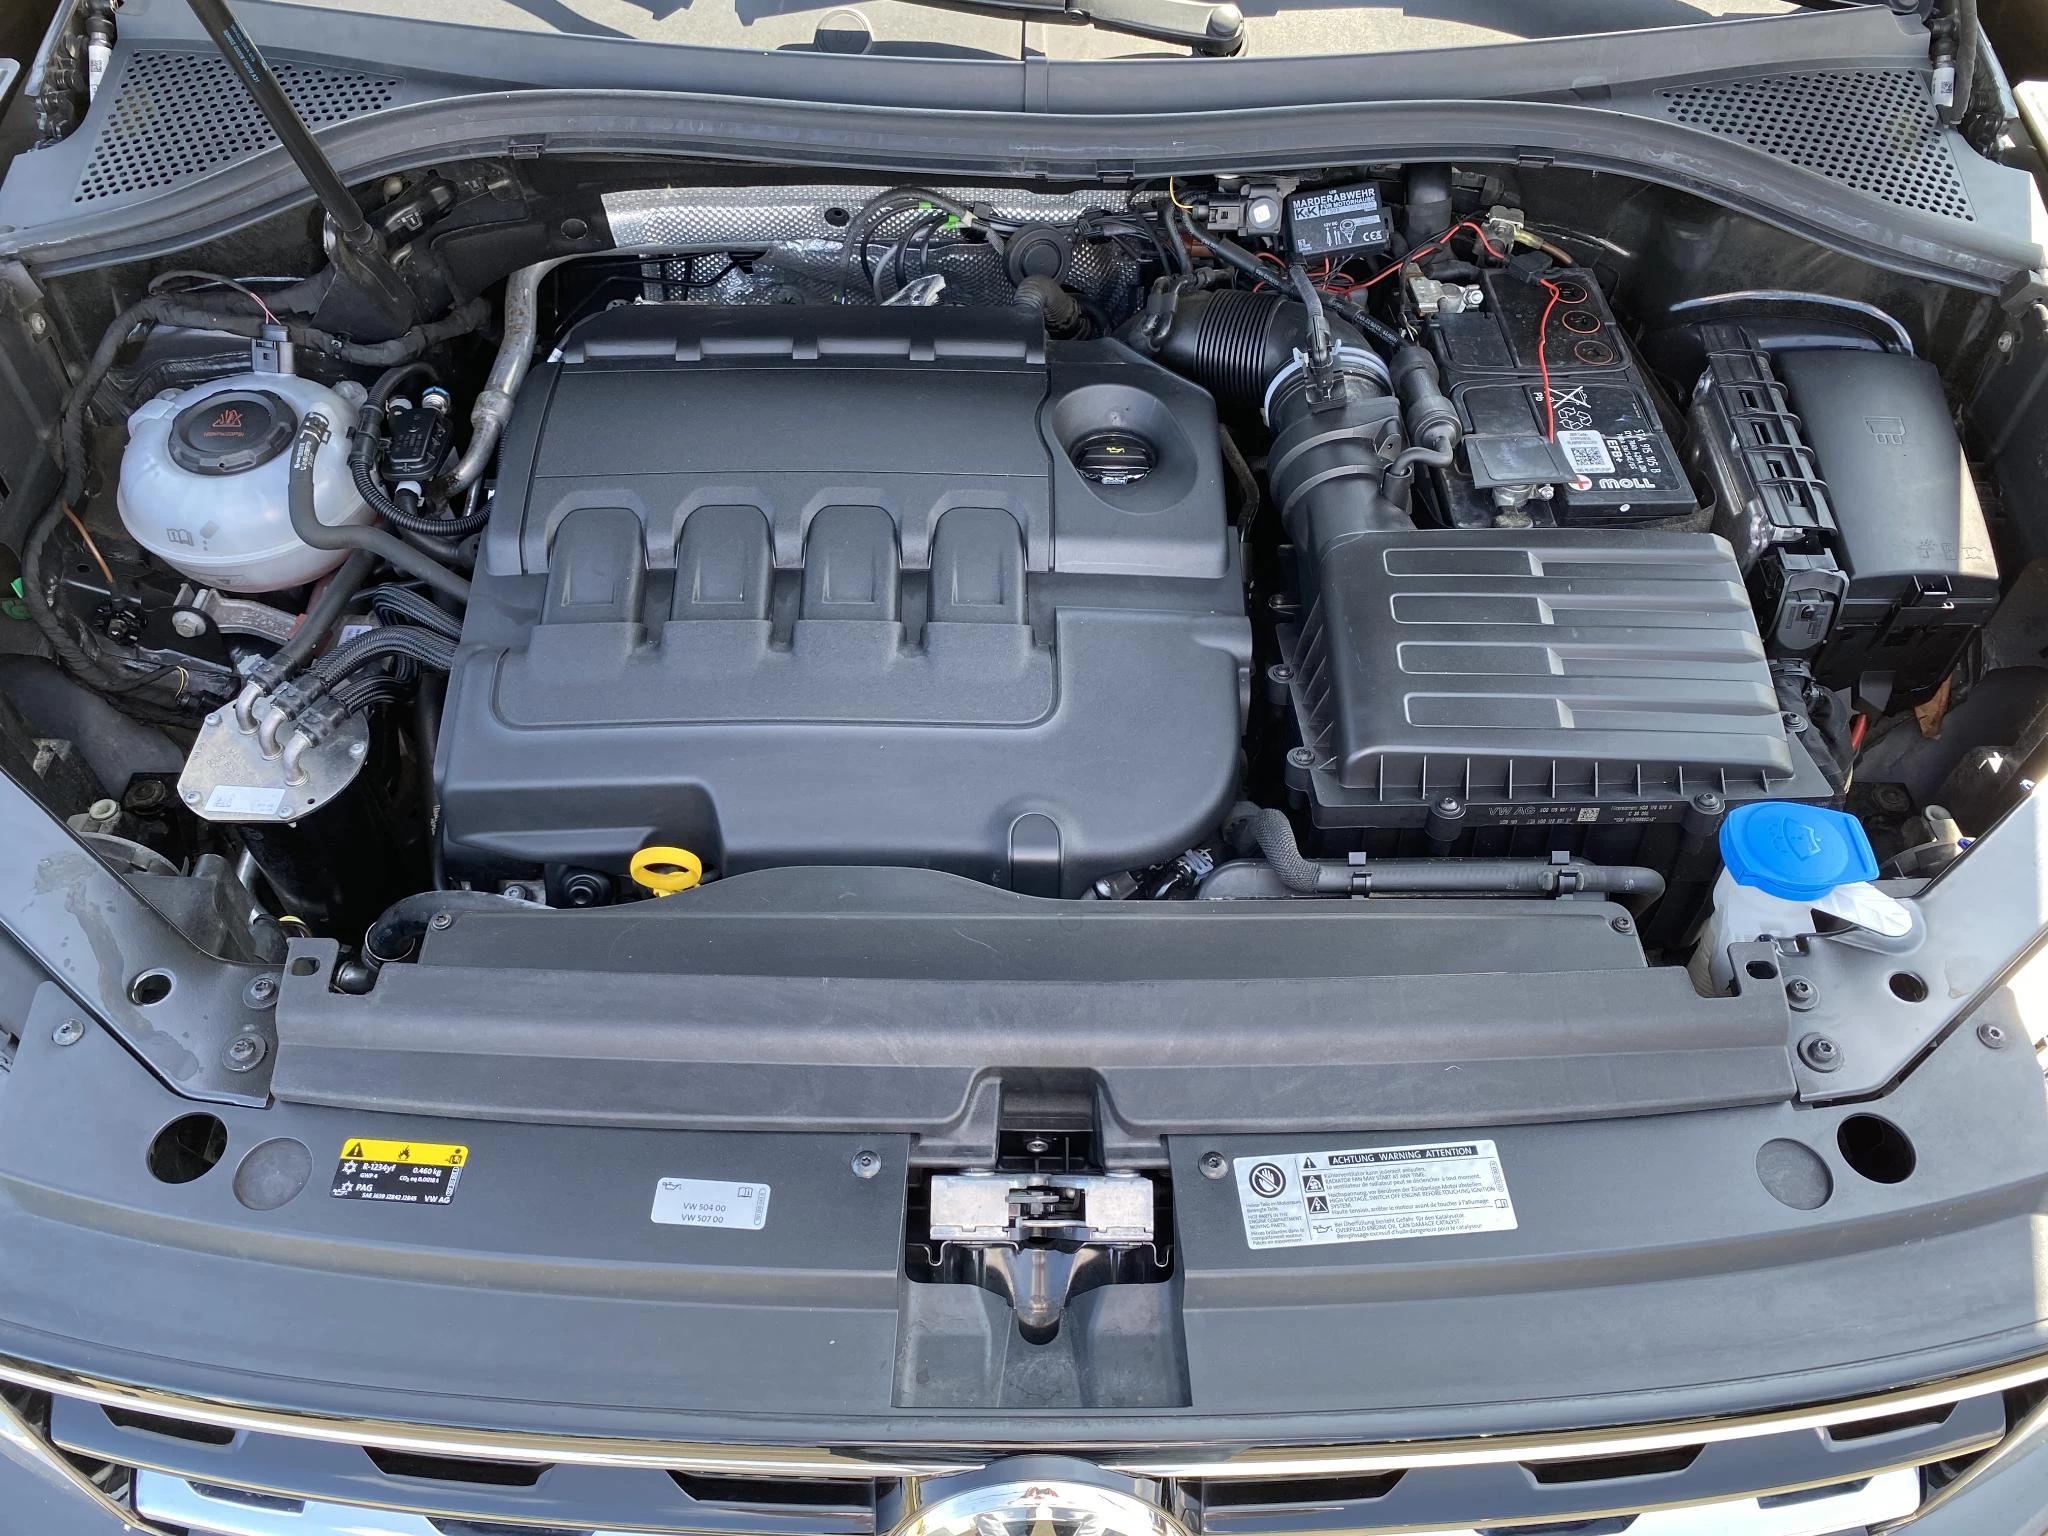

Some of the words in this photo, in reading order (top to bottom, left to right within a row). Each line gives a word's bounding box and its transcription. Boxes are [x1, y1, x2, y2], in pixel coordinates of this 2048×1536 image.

[1293, 188, 1375, 209] MARDERABWEHR
[1333, 196, 1375, 207] MOTORHAUBE
[1533, 392, 1544, 401] Pb
[1607, 439, 1623, 463] EFB+
[1640, 443, 1653, 453] 915
[1646, 456, 1658, 466] 105
[1488, 807, 1513, 815] VW
[1514, 806, 1536, 815] AG
[1332, 1154, 1375, 1165] ACHTUNG
[1379, 1150, 1421, 1161] WARNING
[1425, 1146, 1472, 1158] ATTENTION
[362, 1163, 396, 1173] R-1234yf
[433, 1168, 442, 1177] kg
[355, 1183, 373, 1191] PAG
[424, 1195, 437, 1203] VW
[438, 1196, 450, 1204] AG
[683, 1202, 697, 1210] VW
